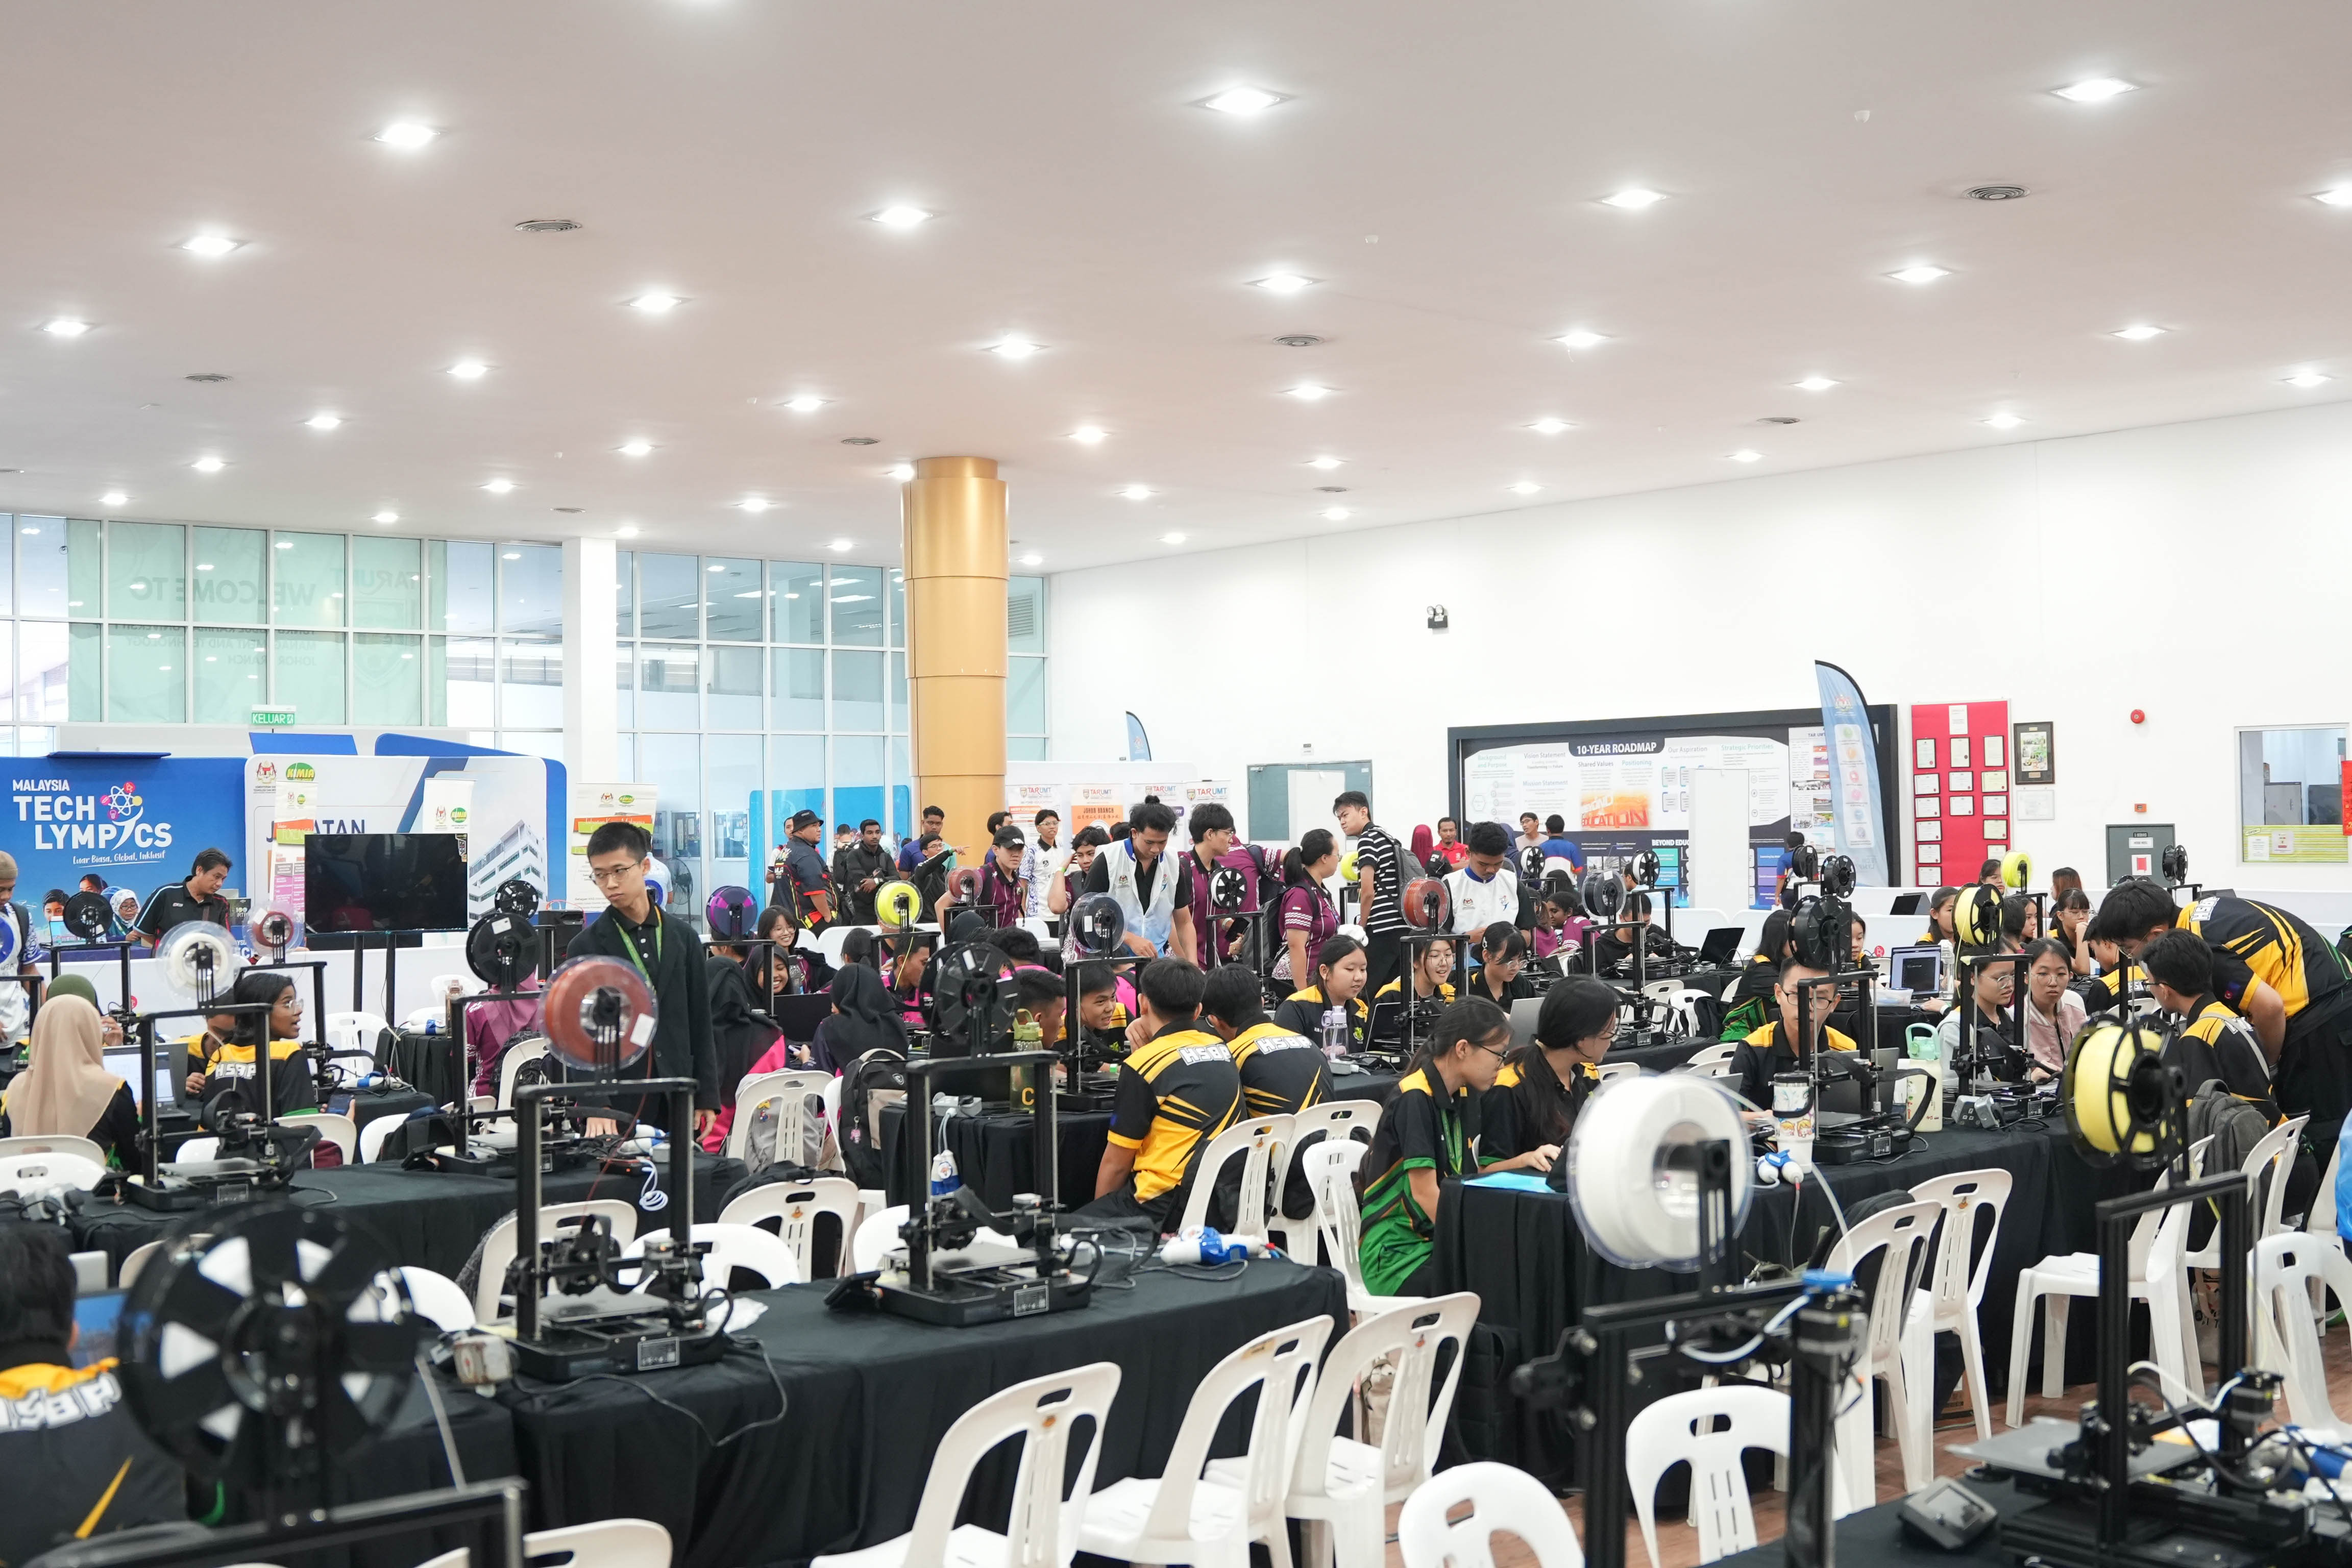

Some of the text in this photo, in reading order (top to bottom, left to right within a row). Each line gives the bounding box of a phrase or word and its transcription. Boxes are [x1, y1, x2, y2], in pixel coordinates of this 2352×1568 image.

[252, 713, 286, 724] KELUAR
[1577, 742, 1657, 755] 10-YEAR ROADMAP
[13, 779, 70, 791] MALAYSIA
[13, 796, 95, 821] TECH
[73, 850, 166, 864] Luar Biasa, Global, Inklusif
[1254, 1035, 1312, 1055] HSBP
[1177, 1044, 1232, 1066] HSBP
[0, 1372, 121, 1433] SBP
